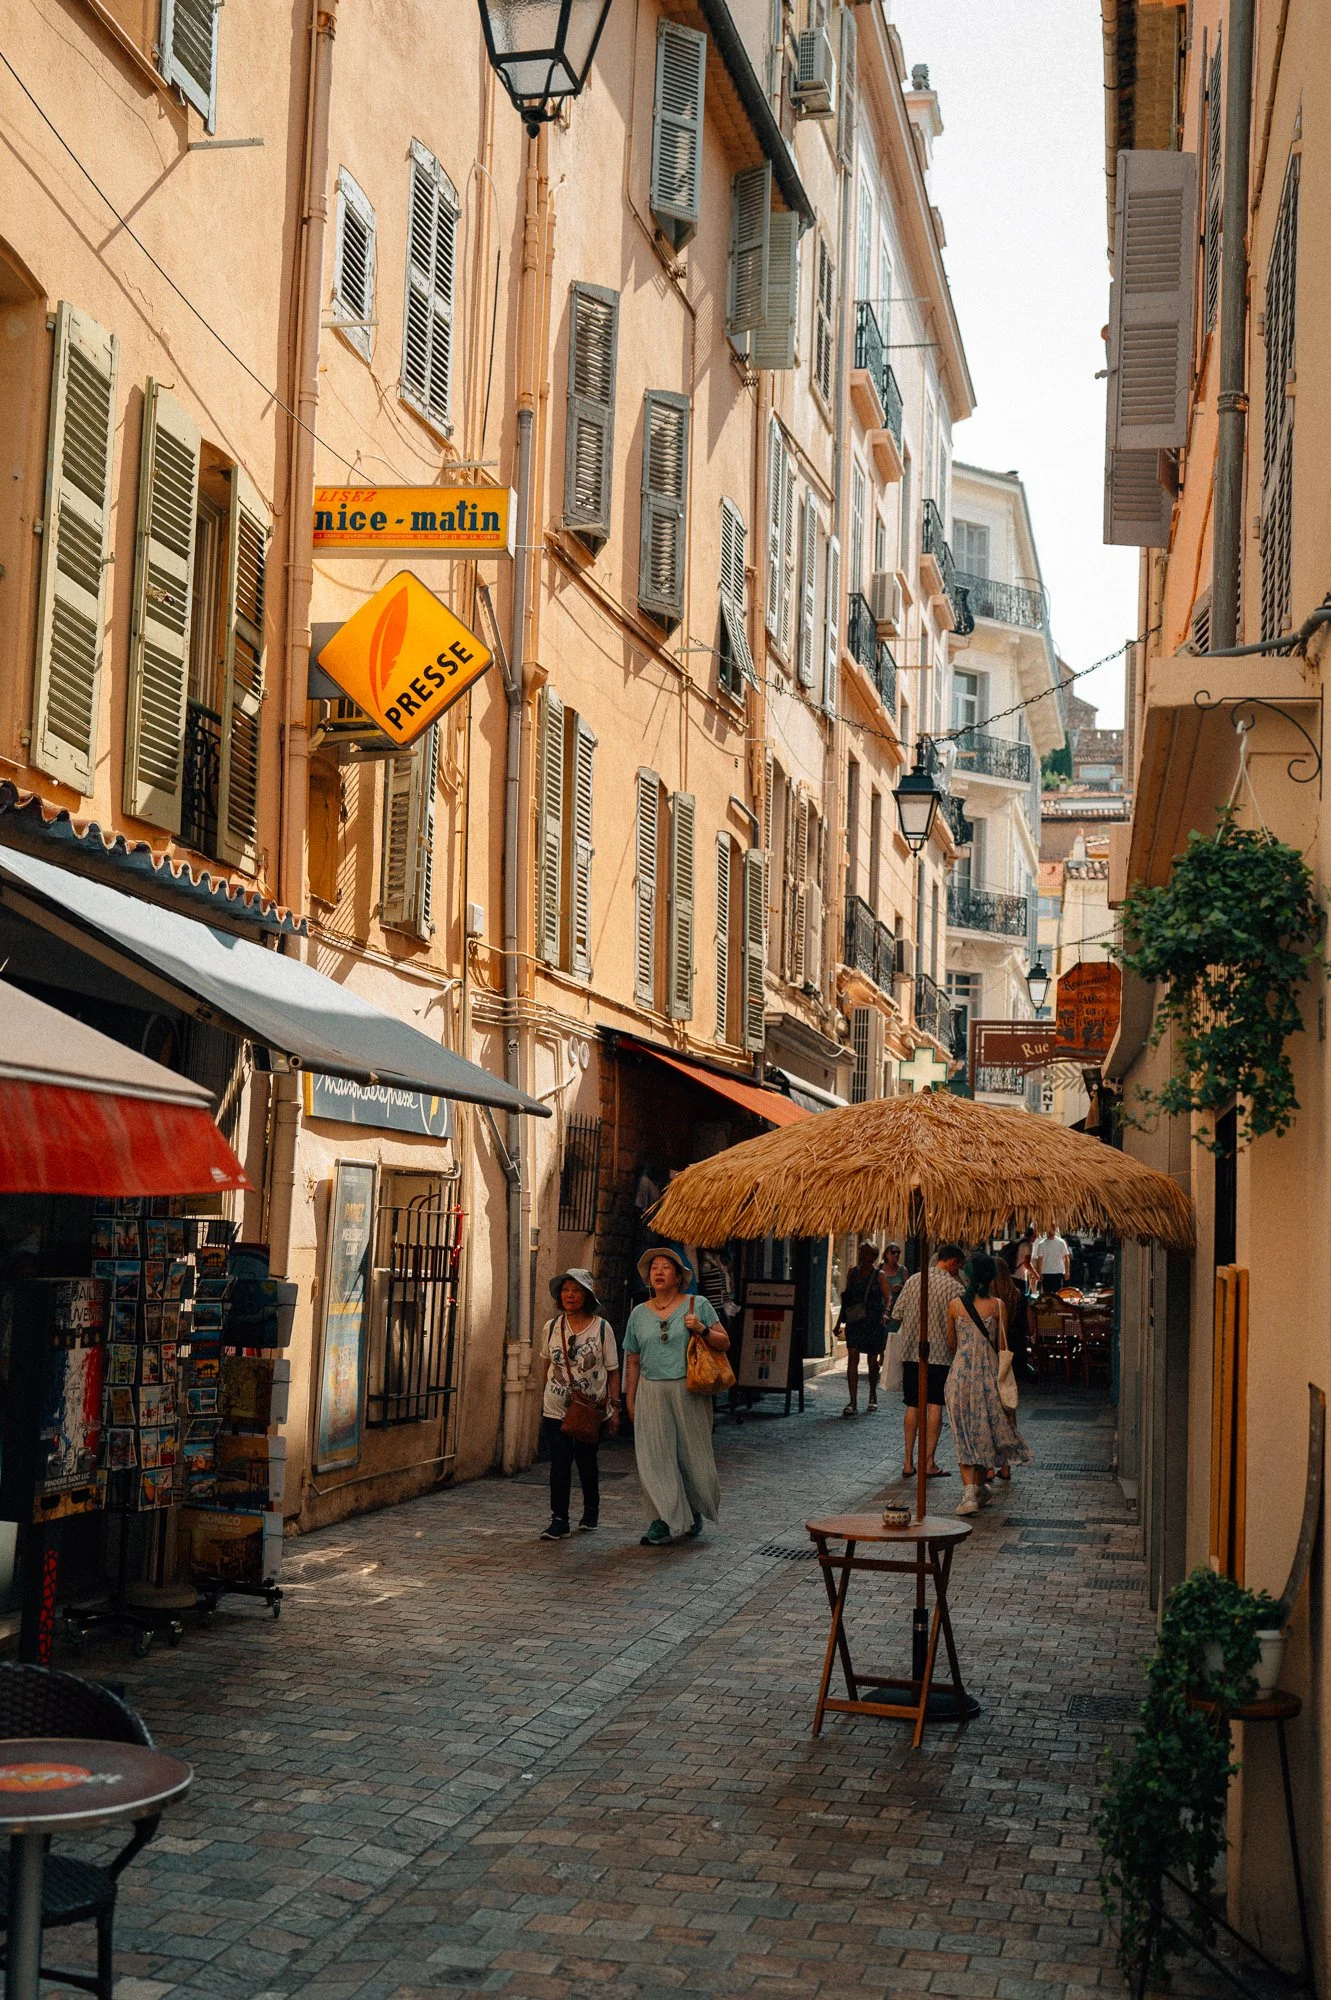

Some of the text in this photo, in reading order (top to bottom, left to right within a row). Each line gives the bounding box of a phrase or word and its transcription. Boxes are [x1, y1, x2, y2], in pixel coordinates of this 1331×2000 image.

[317, 490, 377, 502] LISEZ
[315, 503, 387, 531] nice
[411, 499, 500, 531] matin
[385, 640, 474, 731] PRESSE
[1021, 1042, 1049, 1058] Rue
[199, 1513, 241, 1525] MONACO
